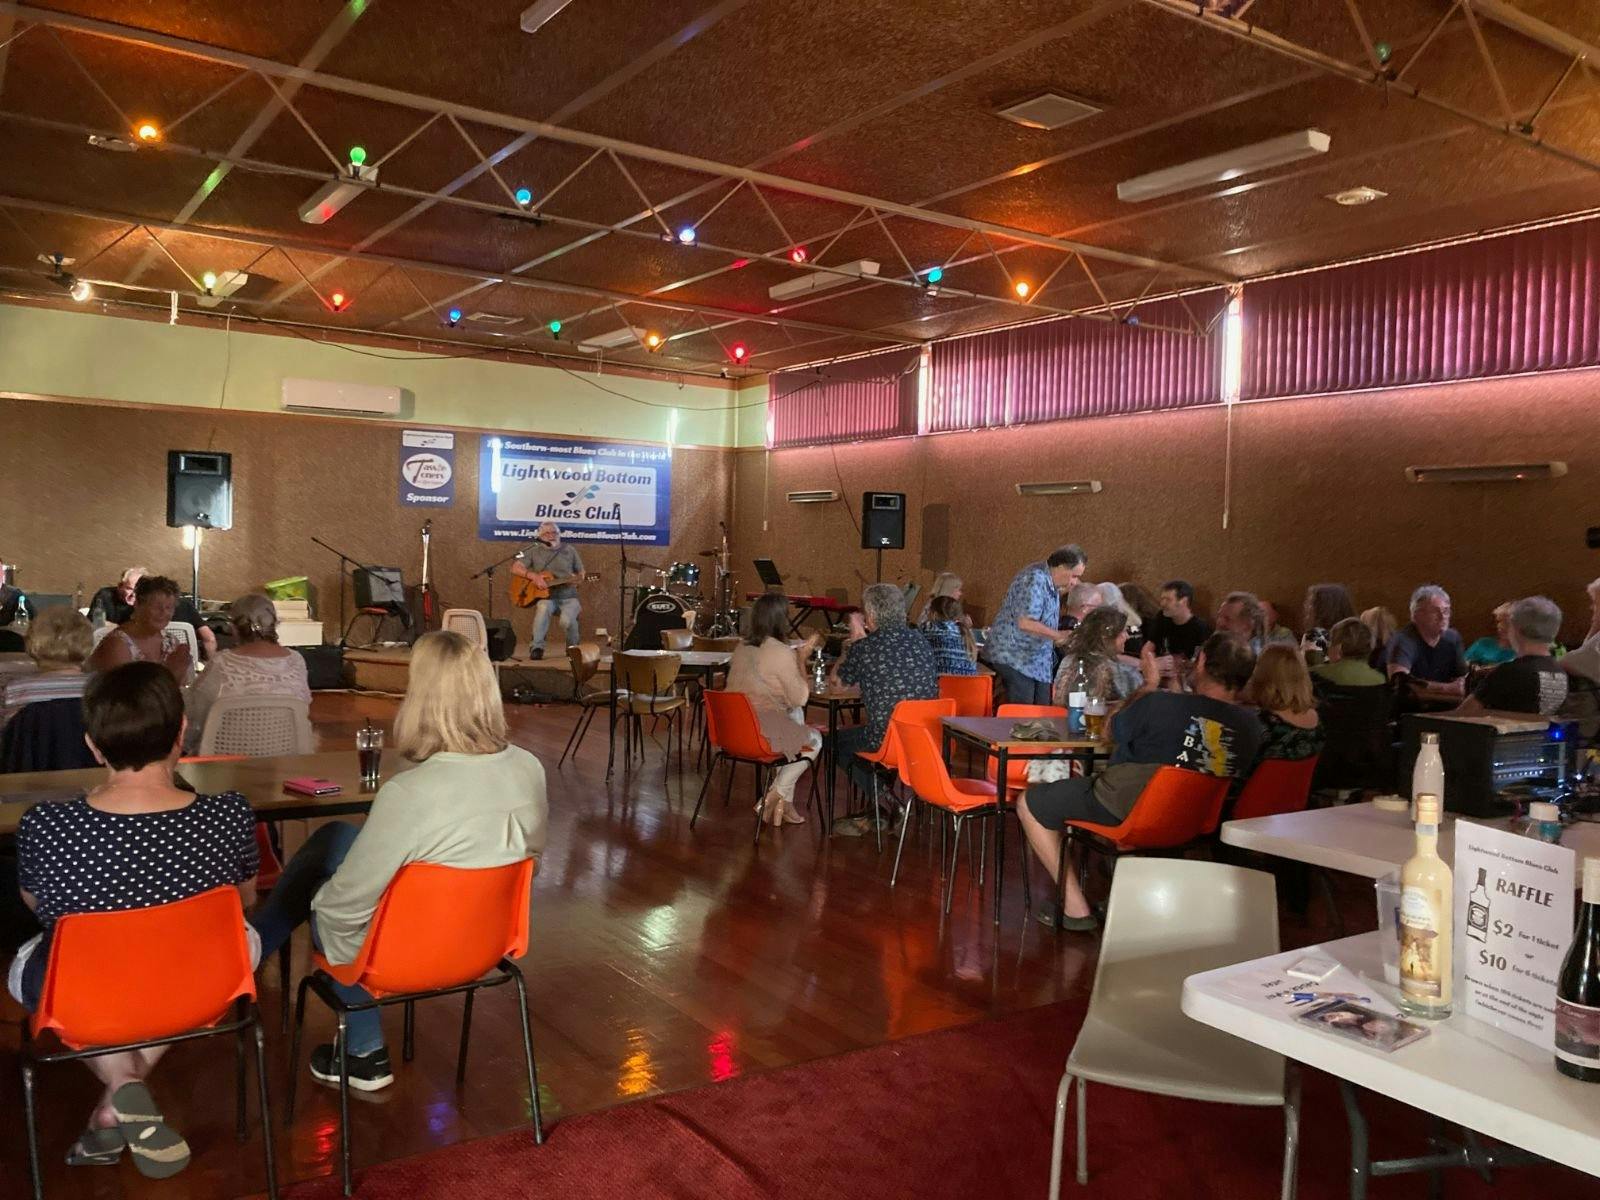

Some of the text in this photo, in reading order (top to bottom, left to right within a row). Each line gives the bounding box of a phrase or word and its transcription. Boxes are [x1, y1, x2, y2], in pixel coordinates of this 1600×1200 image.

[573, 446, 597, 456] Blues
[597, 448, 617, 457] Club
[502, 463, 652, 485] Lightwood Bottom
[406, 492, 449, 503] Sponsor
[535, 503, 621, 520] Blues Club
[1543, 865, 1559, 875] Club
[1496, 878, 1555, 908] RAFFLE
[1493, 919, 1514, 938] $2
[1537, 937, 1560, 950] ticket
[1479, 949, 1507, 971] $10
